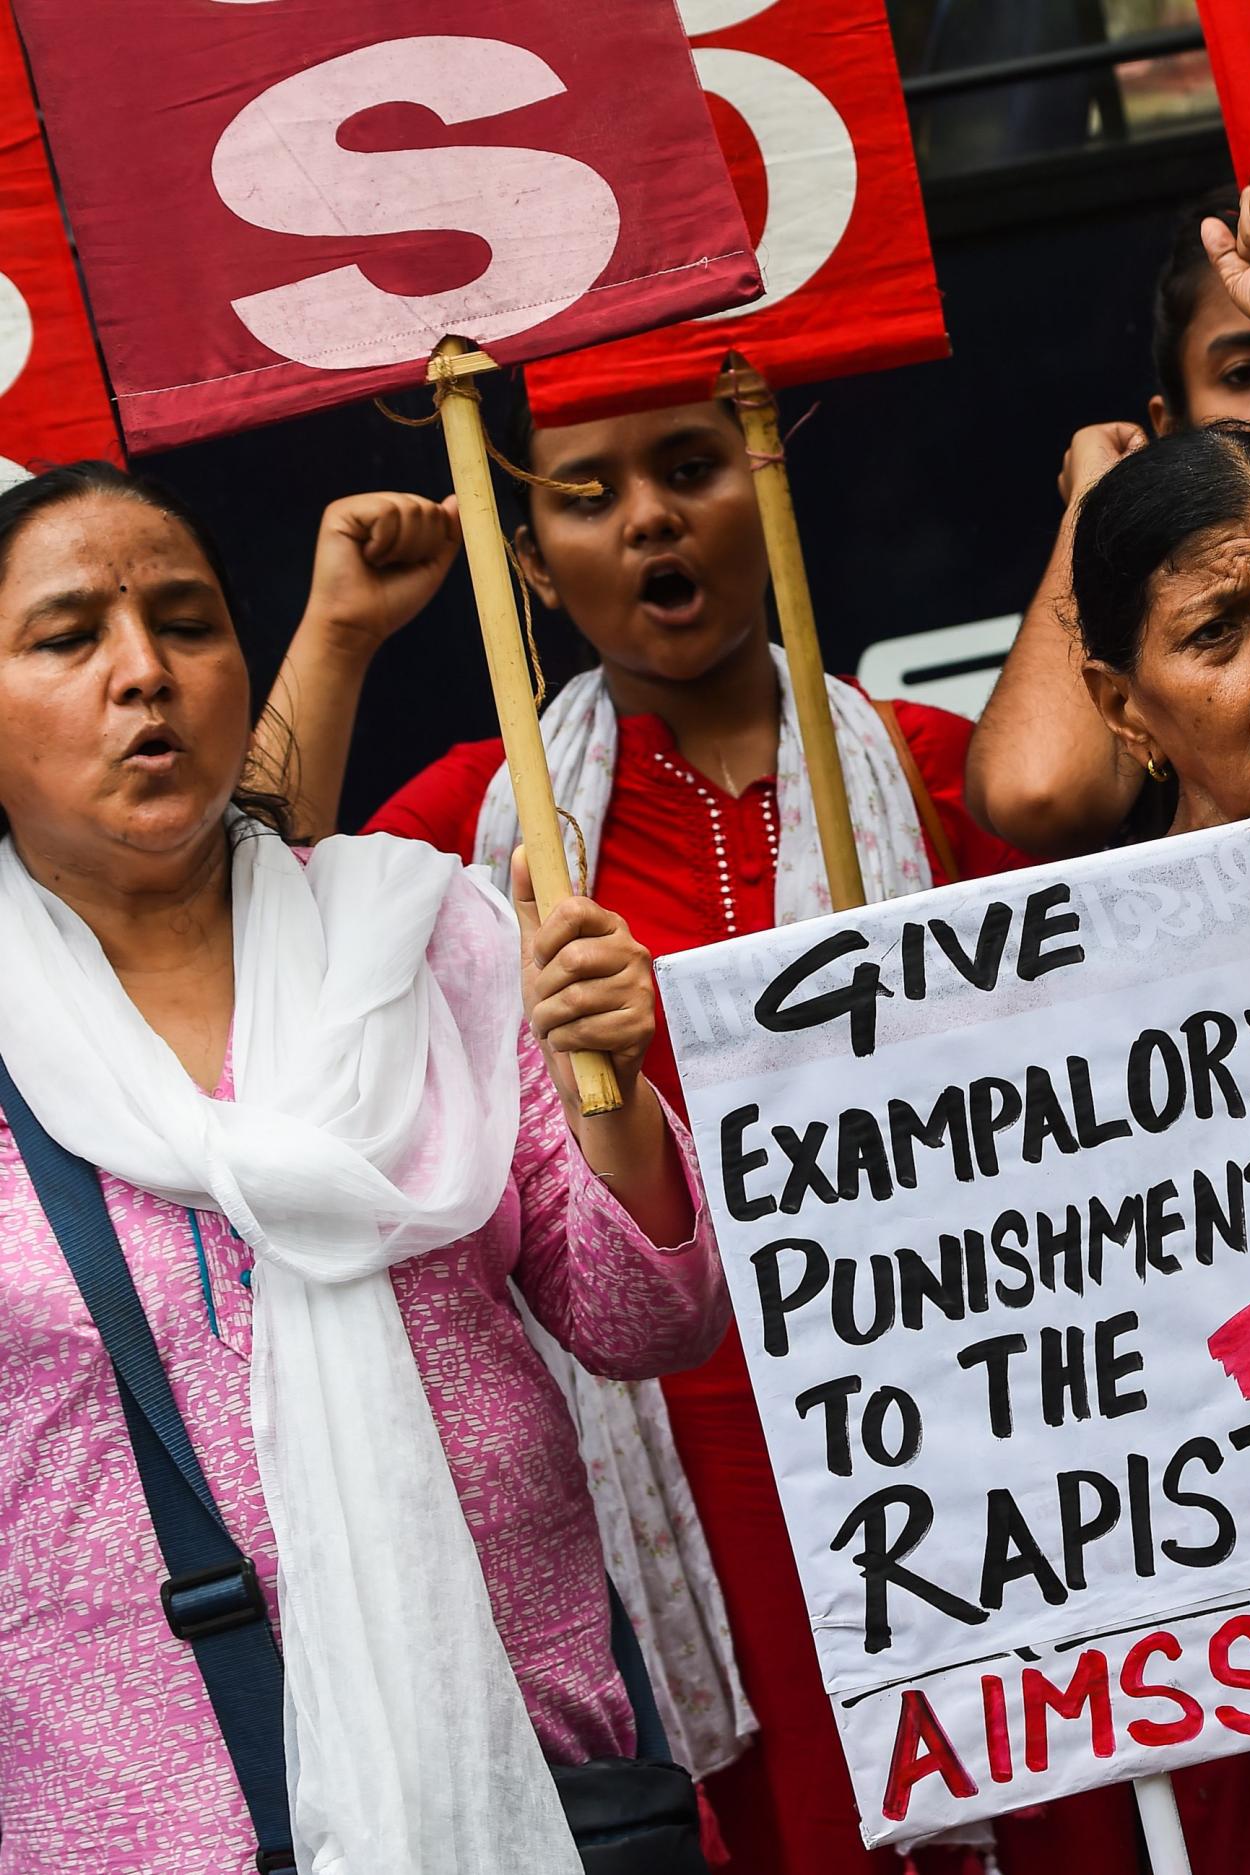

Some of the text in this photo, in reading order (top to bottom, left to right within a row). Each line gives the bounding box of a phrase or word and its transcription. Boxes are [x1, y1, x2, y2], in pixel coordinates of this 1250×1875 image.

[211, 35, 621, 370] S
[754, 882, 1086, 1058] GIVE
[794, 1310, 1148, 1477] TO THE
